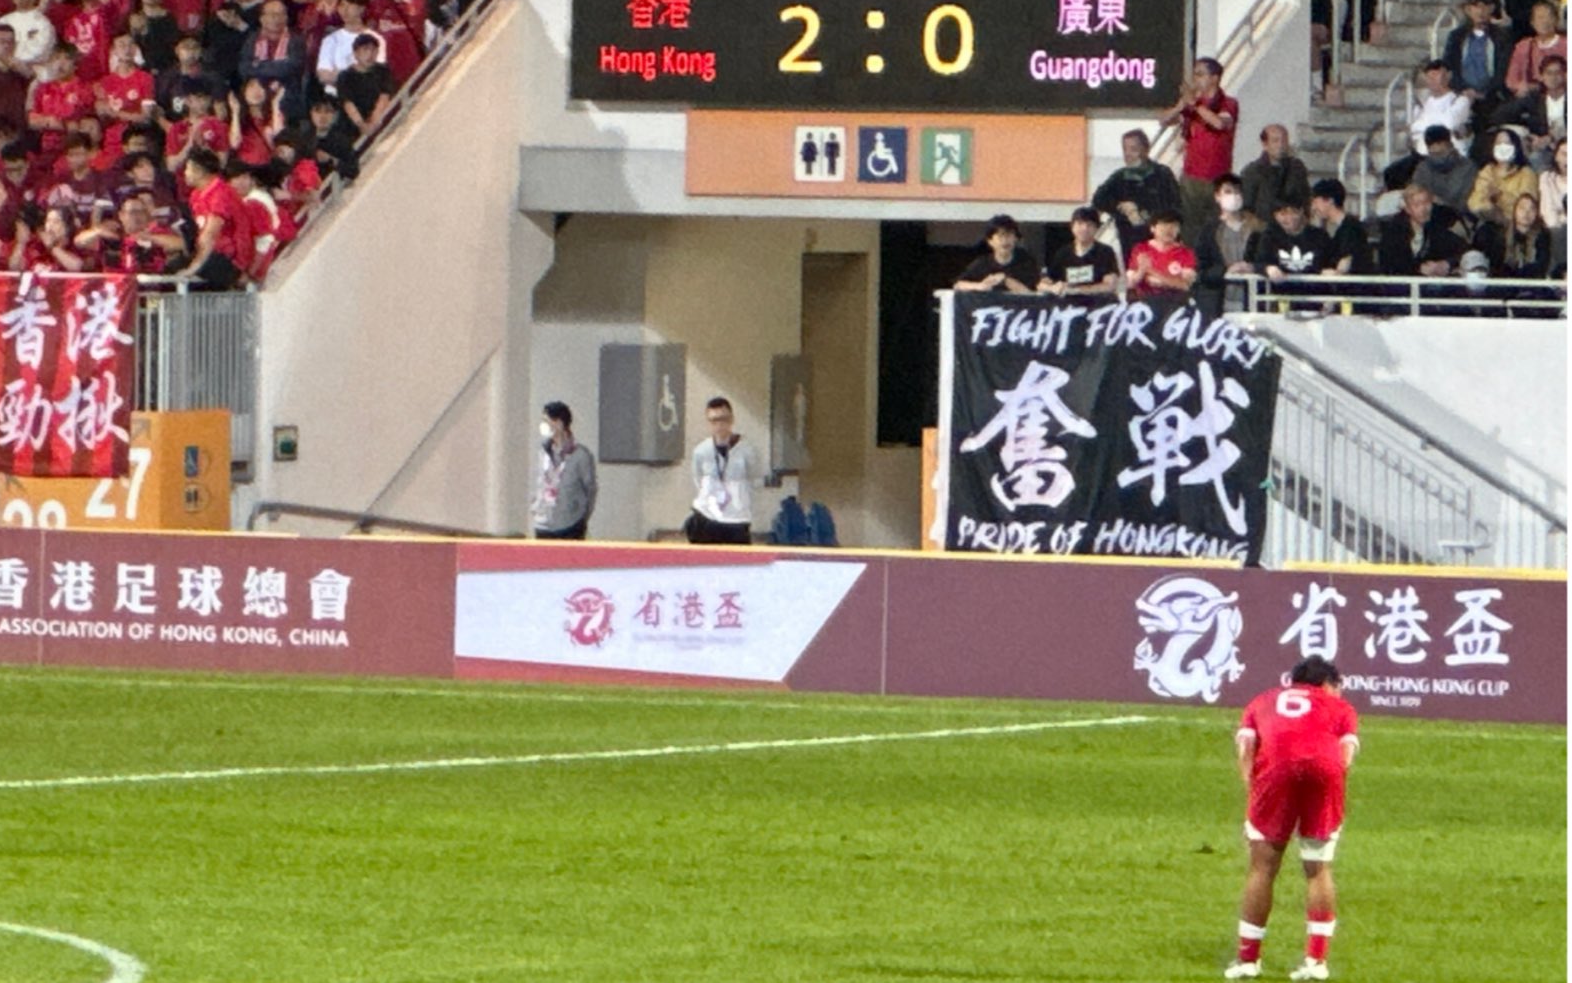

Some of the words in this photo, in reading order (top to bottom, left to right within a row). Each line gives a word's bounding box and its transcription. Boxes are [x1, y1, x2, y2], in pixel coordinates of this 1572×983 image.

[777, 4, 824, 73] 2
[922, 4, 975, 76] 0
[599, 45, 657, 82] Hong
[662, 45, 717, 83] Kong
[1029, 50, 1157, 89] Guangdong
[969, 303, 1087, 354] FIGHT
[1085, 298, 1158, 350] FOR
[957, 515, 1048, 552] PRIDE
[632, 590, 746, 630] 省港盃
[1278, 581, 1514, 666] 省港盃
[128, 622, 155, 640] OF
[159, 623, 217, 643] HONG
[222, 626, 283, 647] KONG,
[288, 628, 350, 647] CHINA
[1275, 688, 1312, 718] 6
[1280, 671, 1430, 694] GDONG-HONG
[1432, 677, 1476, 696] KONG
[1477, 678, 1510, 697] CUP
